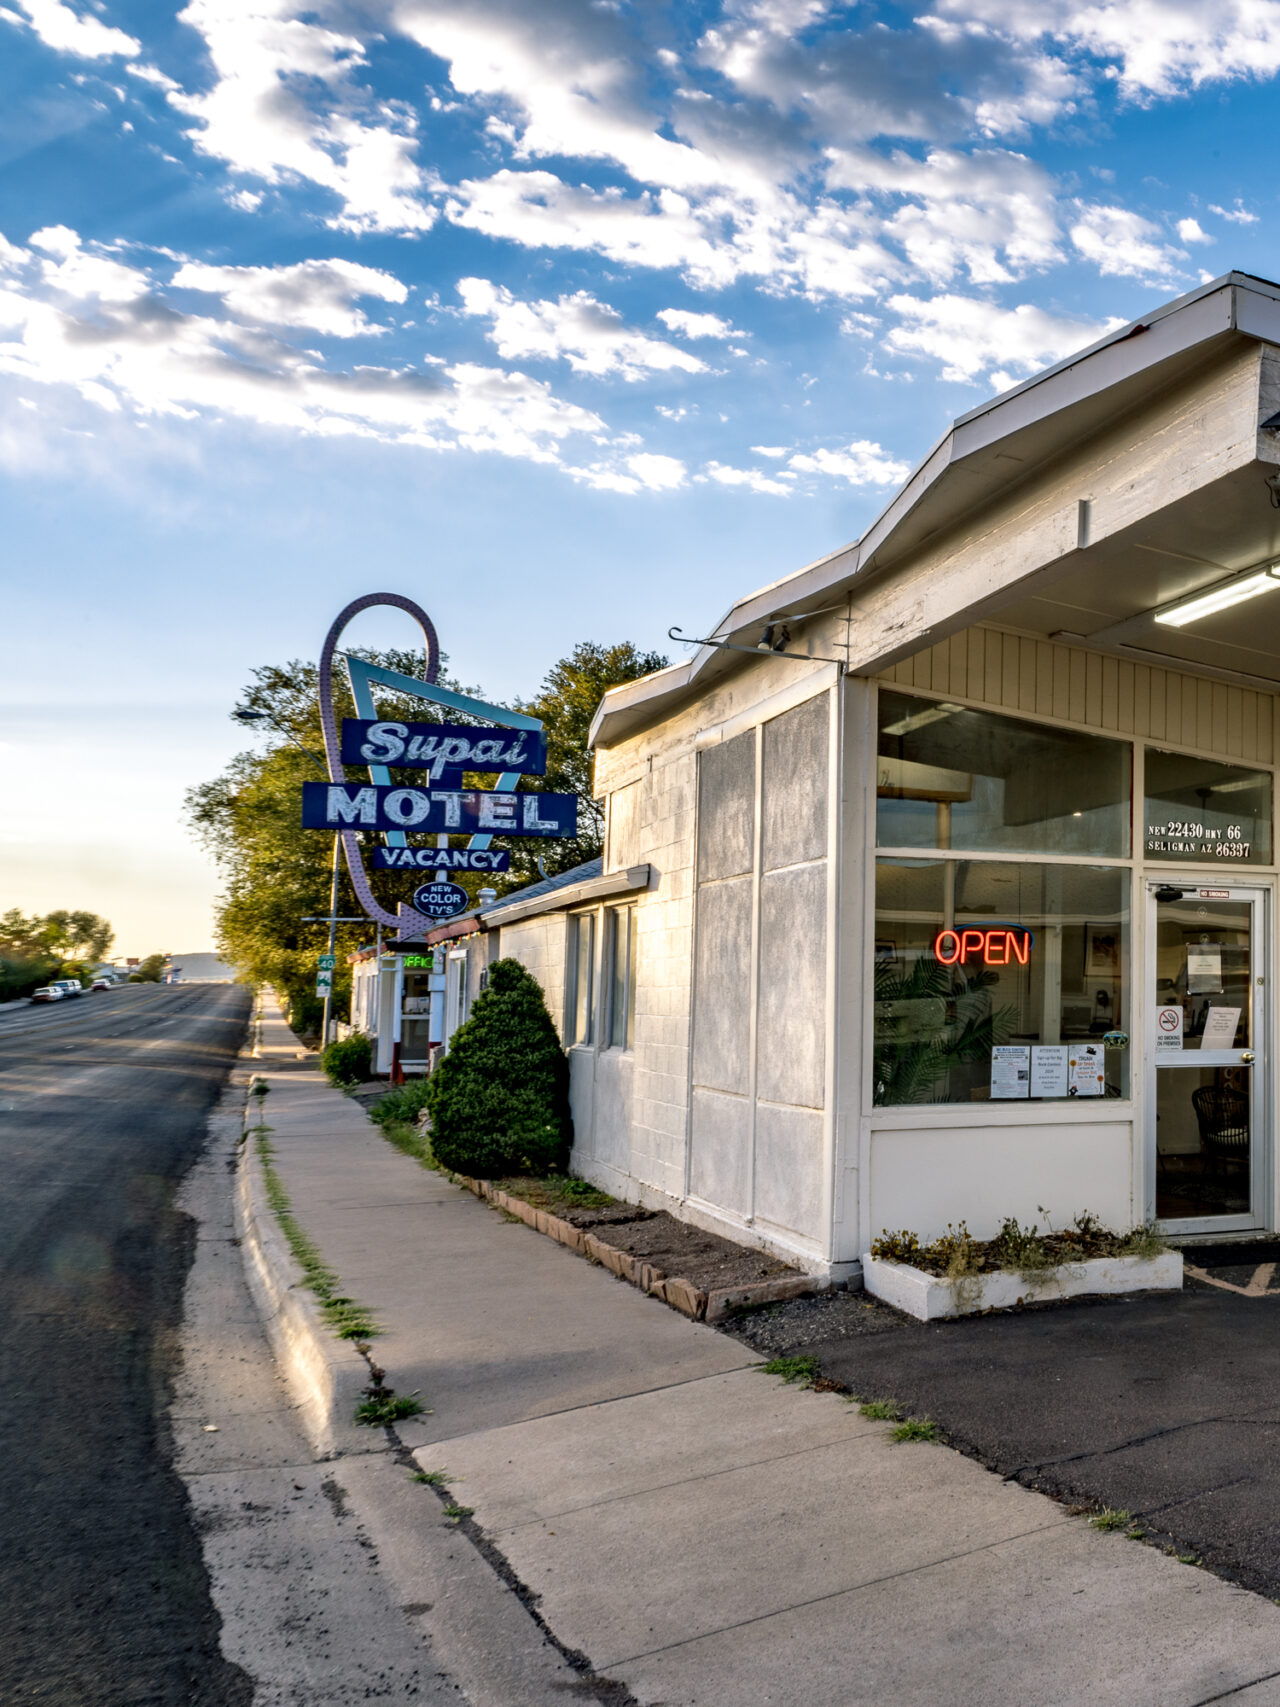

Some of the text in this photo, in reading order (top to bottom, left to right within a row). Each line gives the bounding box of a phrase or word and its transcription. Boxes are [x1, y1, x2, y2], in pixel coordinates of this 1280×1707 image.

[360, 721, 528, 780] Supai
[326, 785, 559, 831] MOTEL
[1148, 825, 1166, 836] NEW
[1168, 821, 1203, 838] 22430
[1227, 825, 1241, 840] 66
[1148, 840, 1250, 857] SELIGMAN AZ 86337
[381, 848, 505, 868] VACANCY
[430, 885, 452, 893] NEW
[420, 893, 462, 904] COLOR
[428, 905, 454, 914] TV'S
[935, 930, 1029, 965] OPEN
[321, 960, 334, 969] 40
